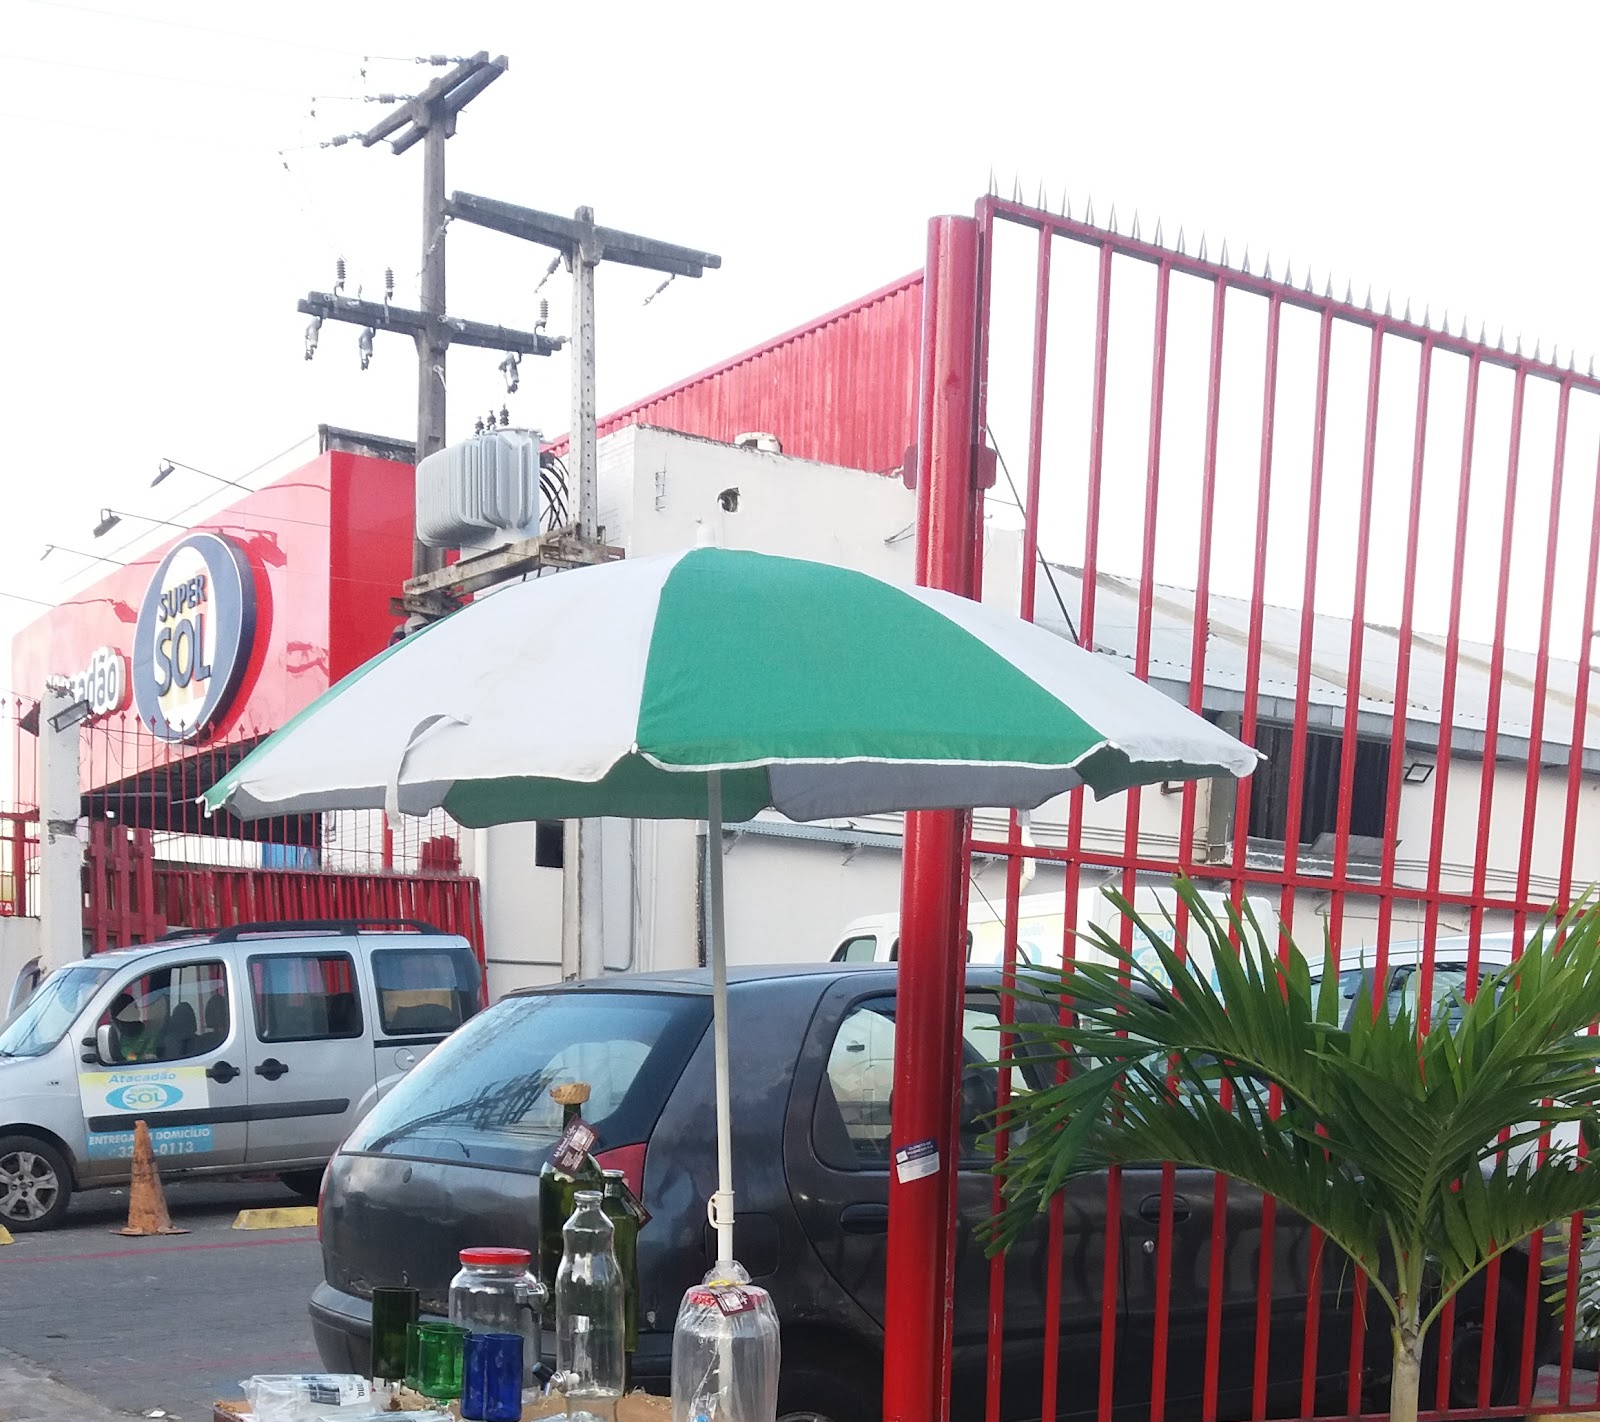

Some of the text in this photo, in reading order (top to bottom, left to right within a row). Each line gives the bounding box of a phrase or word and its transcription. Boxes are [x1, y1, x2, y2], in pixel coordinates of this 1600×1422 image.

[159, 574, 207, 622] SUPER
[154, 613, 211, 697] SOL
[109, 1072, 176, 1083] Atacadão
[126, 1092, 164, 1104] SOL
[89, 1134, 135, 1145] ENTREGA
[119, 1141, 194, 1158] 33-0113
